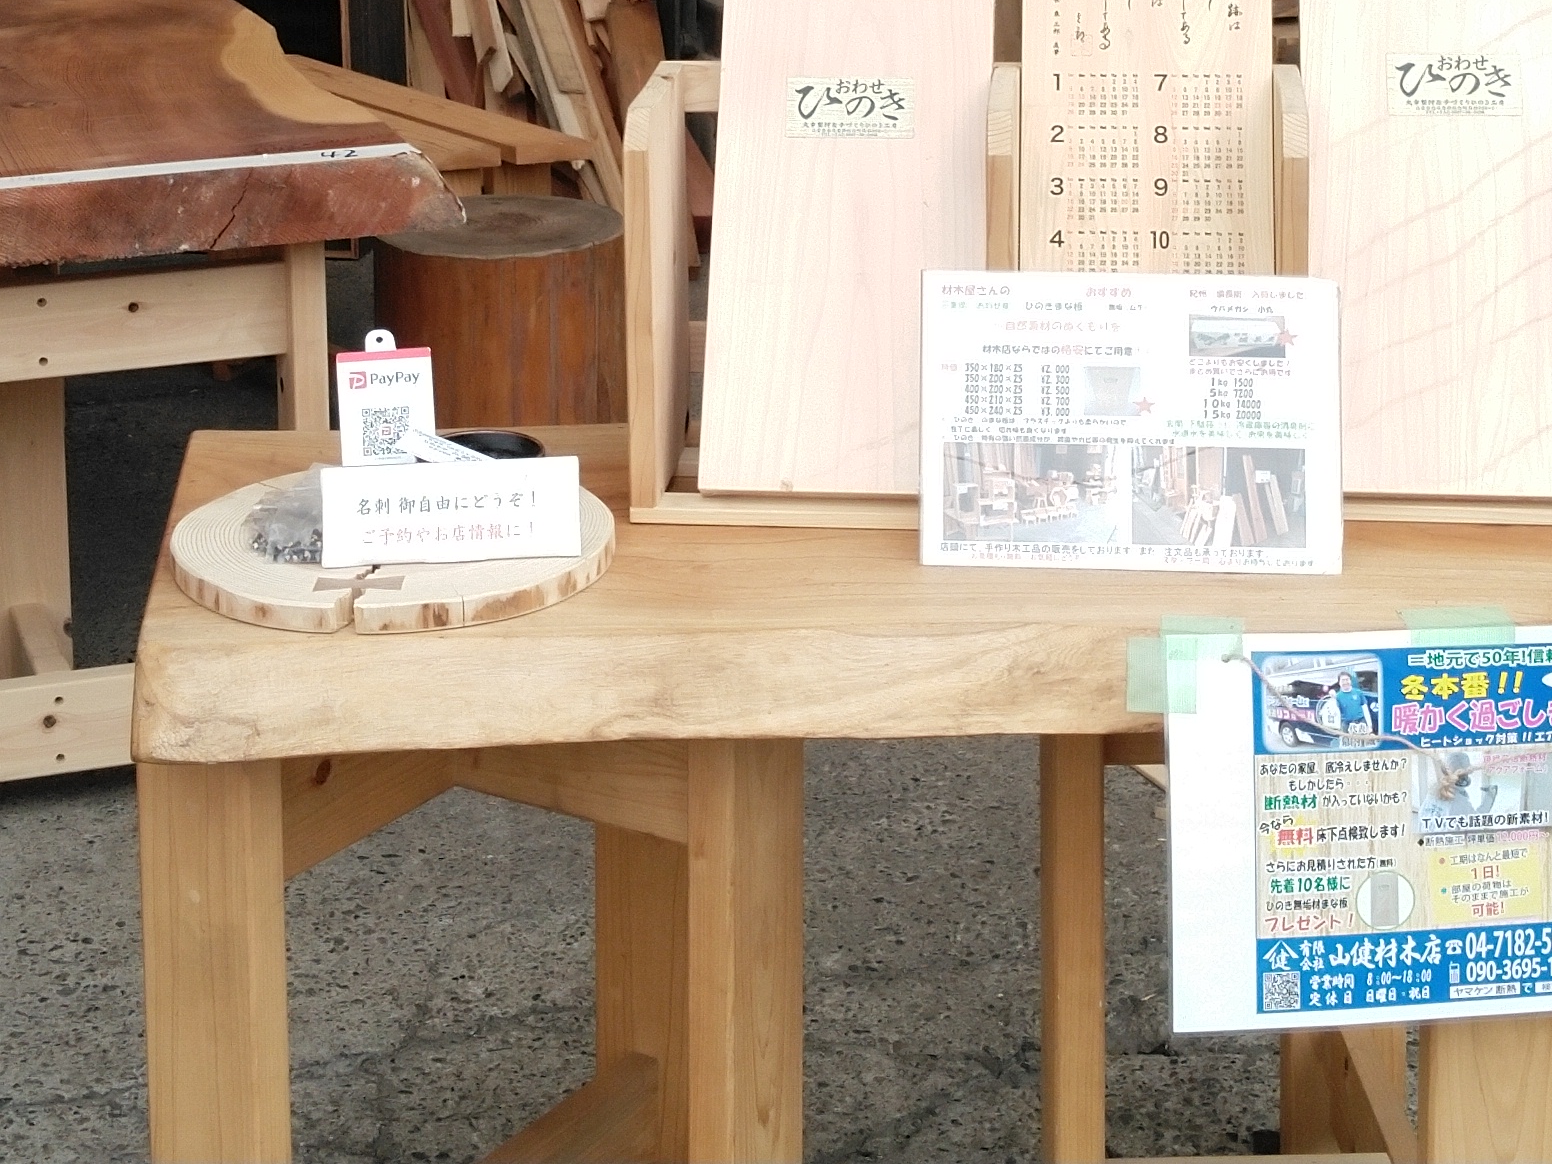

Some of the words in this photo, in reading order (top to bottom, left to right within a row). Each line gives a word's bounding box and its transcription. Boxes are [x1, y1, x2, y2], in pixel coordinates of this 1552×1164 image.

[1437, 55, 1489, 71] おわせ
[836, 79, 886, 95] おわせ
[1052, 73, 1060, 91] 1
[1154, 74, 1168, 91] 7
[1394, 62, 1512, 98] ひのき
[794, 85, 906, 121] ひのき
[1050, 125, 1065, 143] 2
[1154, 126, 1168, 143] 8
[1050, 177, 1064, 195] 3
[1154, 178, 1168, 196] 9
[1049, 230, 1065, 248] 4
[1150, 231, 1170, 249] 10
[370, 370, 420, 385] PayPay
[356, 497, 390, 516] 名刺
[1264, 795, 1318, 810] 断熱材
[1259, 815, 1294, 834] 今なら
[1277, 827, 1314, 845] 無料
[1270, 876, 1351, 894] 先着10名様に
[1451, 879, 1512, 894] 部屋の荷物は
[1471, 902, 1505, 918] 可能!
[1299, 940, 1326, 957] 有限
[1328, 933, 1443, 969] 山健材木店
[1300, 957, 1325, 972] 会社
[1309, 973, 1355, 990] 営業時間
[1453, 984, 1494, 997] ヤマケン
[1496, 981, 1517, 995] 断熱
[1309, 990, 1353, 1007] 定休日
